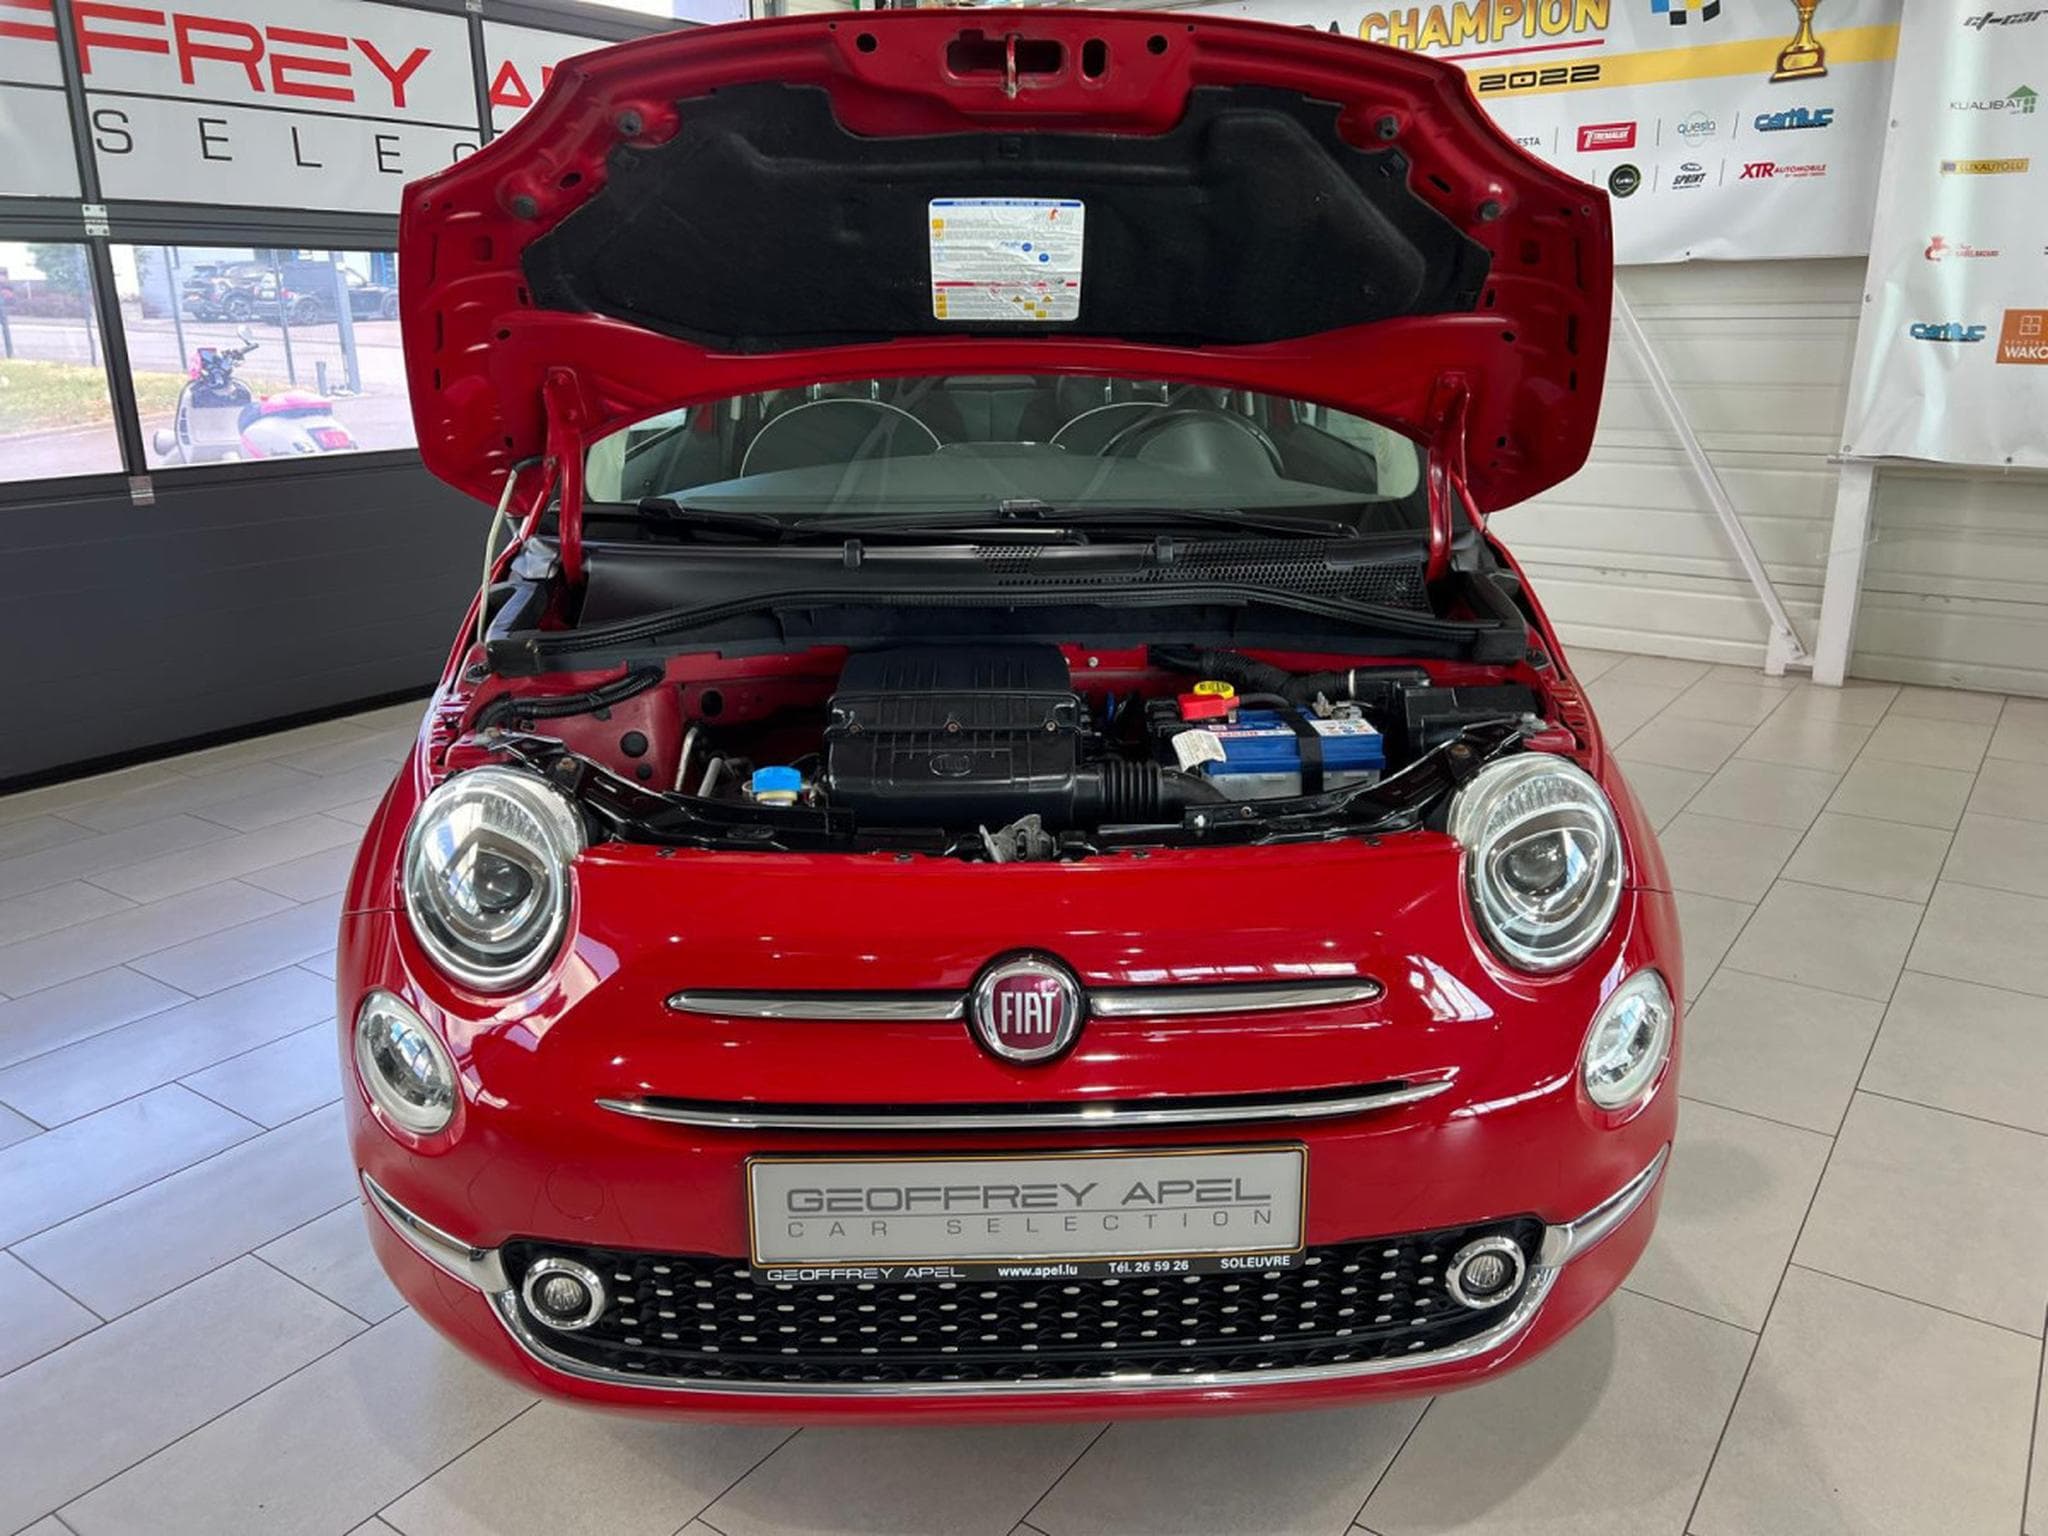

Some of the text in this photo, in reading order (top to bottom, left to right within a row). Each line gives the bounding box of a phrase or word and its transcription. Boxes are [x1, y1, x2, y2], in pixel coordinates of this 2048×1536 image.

[1359, 0, 1610, 50] CHAMPION
[489, 60, 555, 108] A
[1479, 64, 1600, 91] 2022
[1513, 137, 1542, 147] ESTA
[1673, 172, 1707, 185] SPRINT
[1740, 162, 1775, 179] XTR
[1001, 992, 1057, 1034] FIAT
[787, 1178, 1271, 1212] GEOFFREY APEL
[787, 1209, 1271, 1238] CAR SELECTION
[767, 1267, 894, 1281] GEOFFREY
[904, 1266, 965, 1279] APEL
[998, 1264, 1078, 1279] www.apel.lu
[1134, 1261, 1150, 1273] 26
[1154, 1260, 1170, 1272] 59
[1173, 1260, 1189, 1271] 26
[1220, 1255, 1290, 1269] SOLEUVRE
